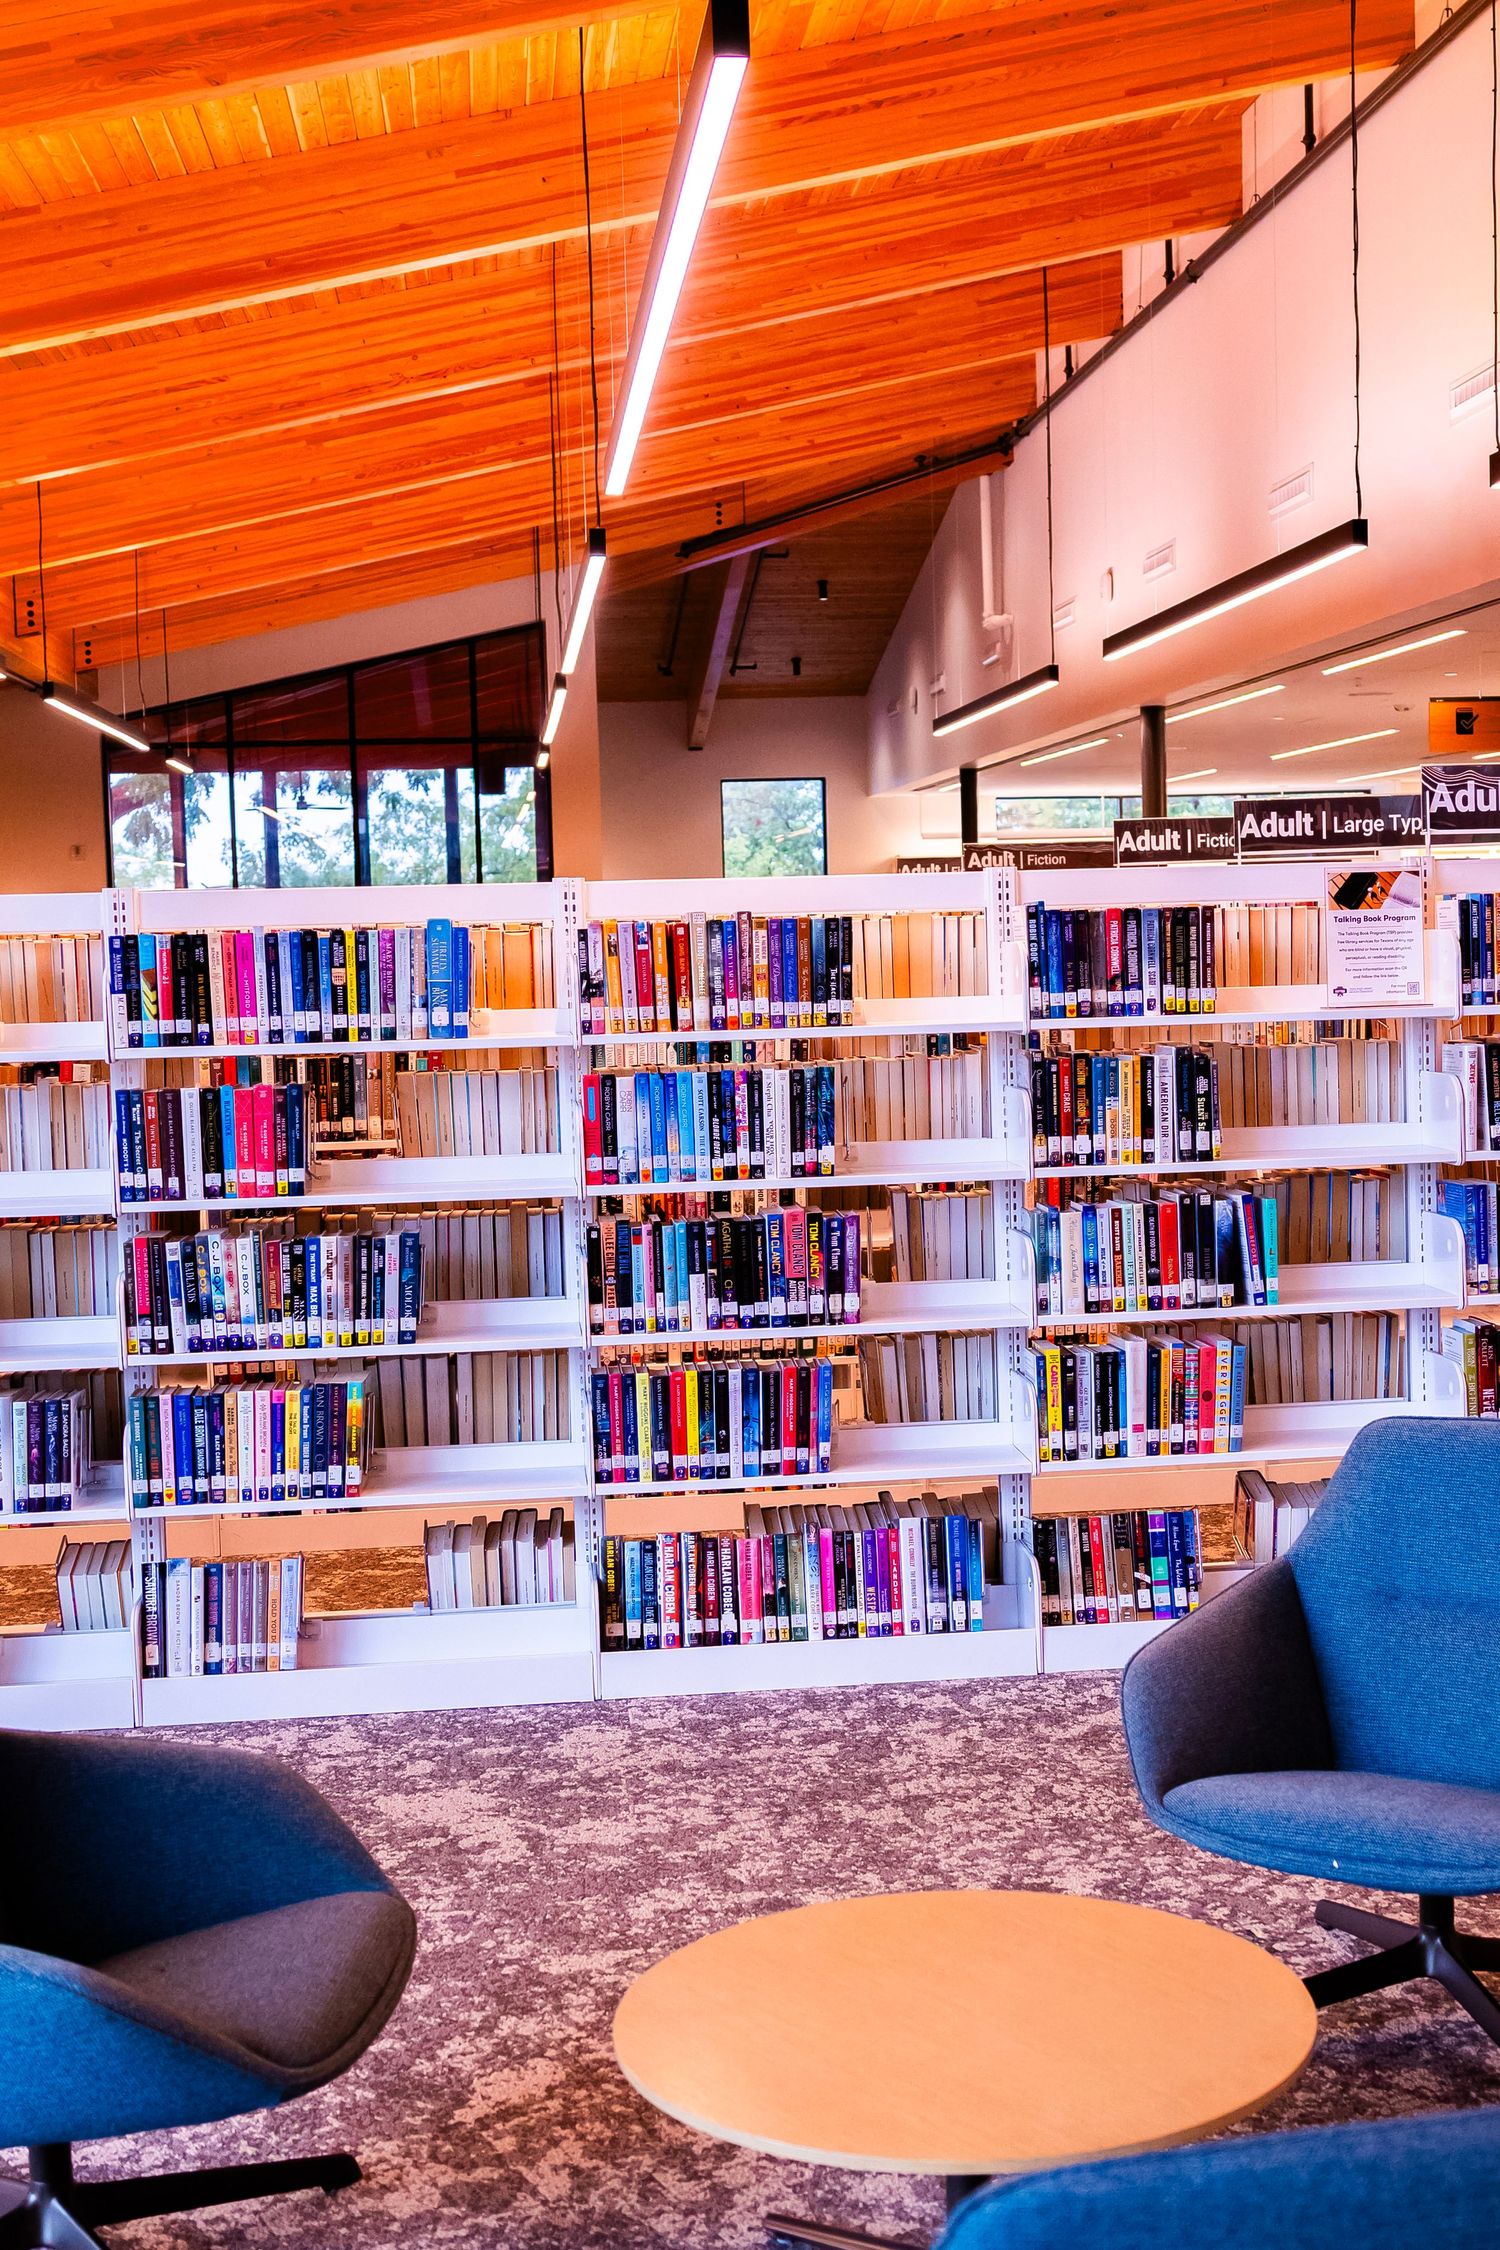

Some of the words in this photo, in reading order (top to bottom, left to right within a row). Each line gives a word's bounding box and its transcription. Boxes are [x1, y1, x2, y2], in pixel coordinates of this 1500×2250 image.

[1430, 780, 1500, 813] Adu
[1240, 811, 1314, 838] Adult
[1334, 817, 1384, 836] Large
[1388, 814, 1422, 834] Typ
[1119, 829, 1180, 852] Adult
[1197, 833, 1234, 848] Fictio
[968, 851, 1015, 869] Adult
[1027, 854, 1066, 866] Fiction
[1029, 919, 1037, 941] ROBIN
[1147, 920, 1155, 941] PATRICIA
[1334, 916, 1361, 924] Talking
[1384, 914, 1416, 923] Program
[1110, 921, 1119, 945] PATRICIA
[1127, 920, 1136, 949] PATRICIA
[431, 938, 439, 975] SUMMER
[439, 941, 447, 971] FIREFLY
[1030, 943, 1038, 962] COOK
[1111, 946, 1119, 975] CORNWELL
[1147, 943, 1156, 968] CORNWELL
[1127, 950, 1138, 983] CORNWELL
[713, 967, 721, 993] HARBOR
[1077, 1059, 1085, 1085] CRICHTON
[1077, 1088, 1086, 1117] PATTERSON
[1197, 1098, 1205, 1120] SILENT
[224, 1101, 232, 1136] BLACKSTOCK
[721, 1221, 731, 1254] AGATHA
[770, 1220, 779, 1238] TOM
[792, 1223, 803, 1239] TOM
[809, 1222, 819, 1241] TOM
[831, 1231, 840, 1247] Tom
[606, 1238, 614, 1251] LEE
[771, 1240, 780, 1275] CLANCY
[606, 1253, 615, 1272] CHILD
[792, 1244, 804, 1275] CLANCY
[810, 1243, 819, 1278] CLANCY
[830, 1249, 840, 1271] Clancy
[185, 1262, 196, 1303] BADLANDS
[199, 1269, 207, 1294] BOX
[213, 1267, 221, 1293] BOX
[608, 1288, 616, 1308] PERSO
[1220, 1351, 1228, 1385] EVERY
[316, 1387, 324, 1407] DAN
[194, 1409, 204, 1424] DALE
[316, 1411, 324, 1445] BROWN
[195, 1425, 205, 1447] BROWN
[645, 1553, 653, 1573] HARLAN
[664, 1546, 675, 1581] HARLAN
[688, 1564, 696, 1586] COBEN
[721, 1548, 732, 1584] HARLAN
[145, 1577, 157, 1613] SANDRA
[645, 1574, 653, 1592] COBEN
[665, 1585, 675, 1613] COBEN
[723, 1586, 733, 1614] COBEN
[146, 1614, 159, 1646] BROWN
